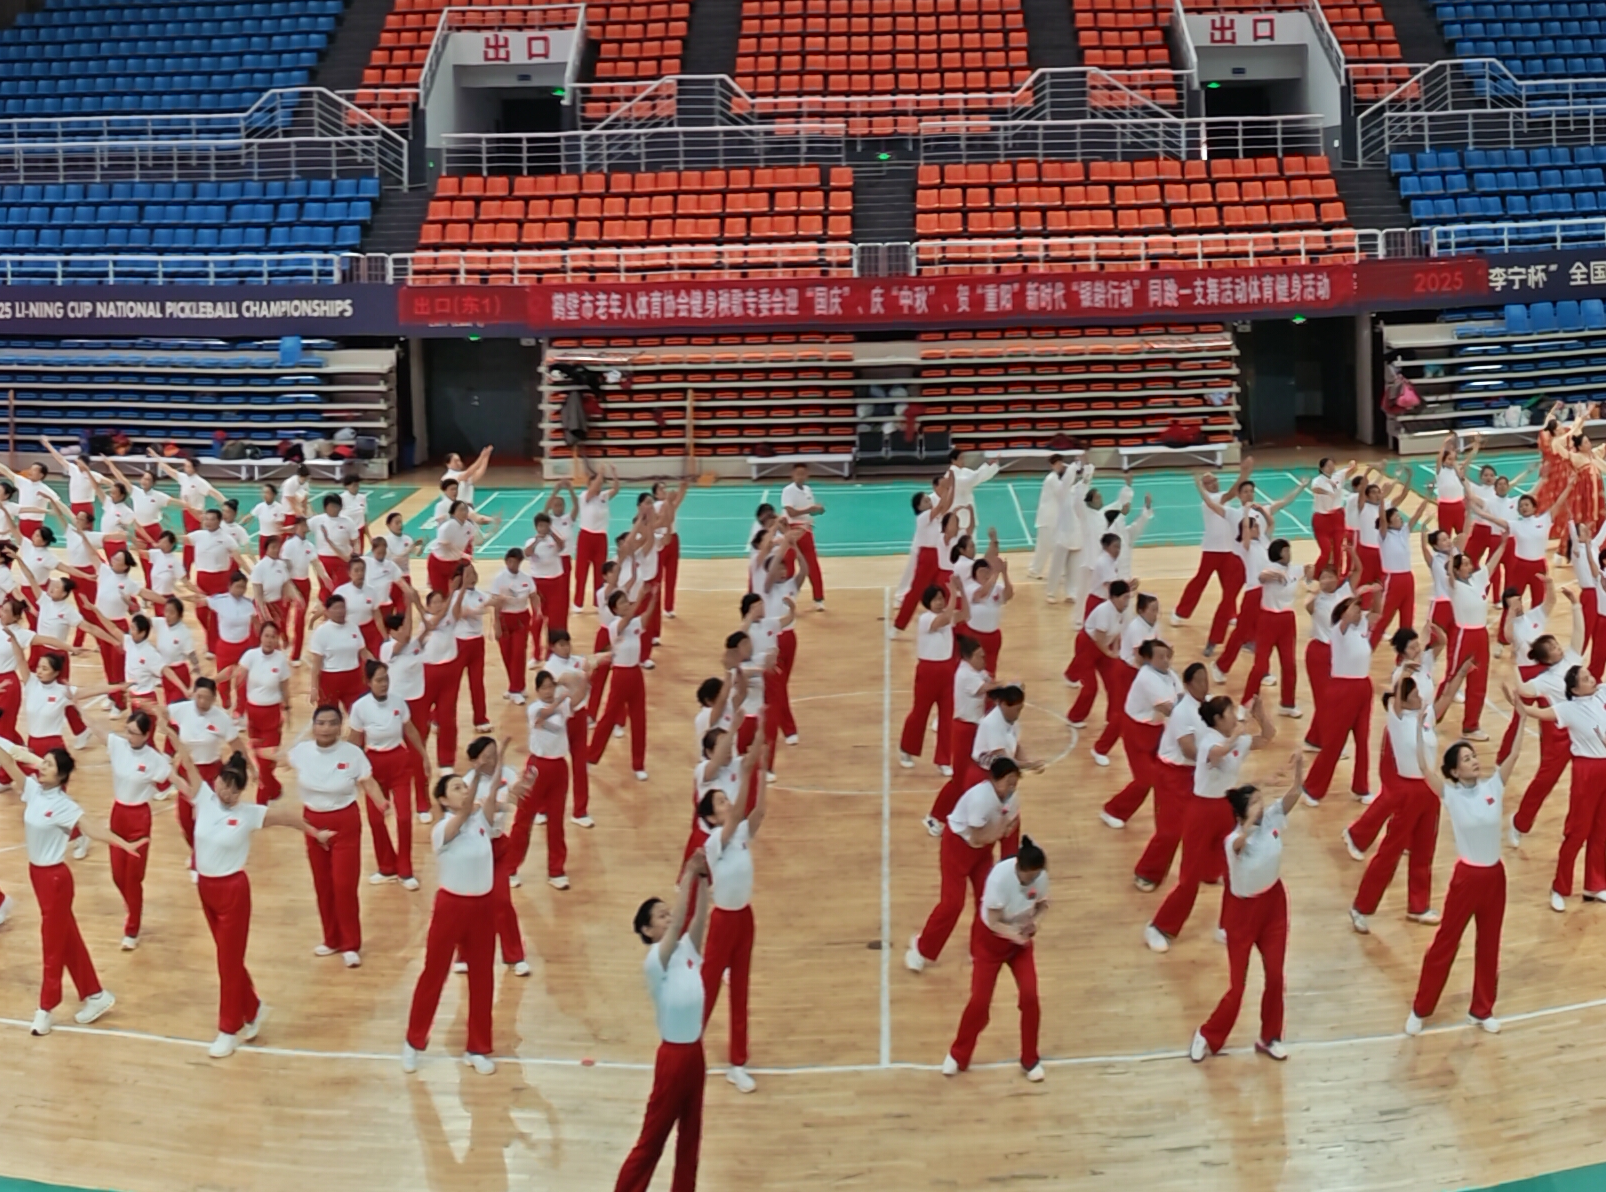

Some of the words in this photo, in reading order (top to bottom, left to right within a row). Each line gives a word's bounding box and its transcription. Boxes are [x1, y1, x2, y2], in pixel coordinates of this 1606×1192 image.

[1210, 15, 1274, 45] 出口
[483, 33, 549, 62] 出口
[1414, 271, 1464, 293] 2025
[15, 301, 64, 319] LI-NING
[67, 302, 93, 319] CUP
[95, 302, 163, 319] NATIONAL
[165, 301, 239, 319] PICKLEBALL
[241, 300, 354, 318] CHAMPIONSHIPS
